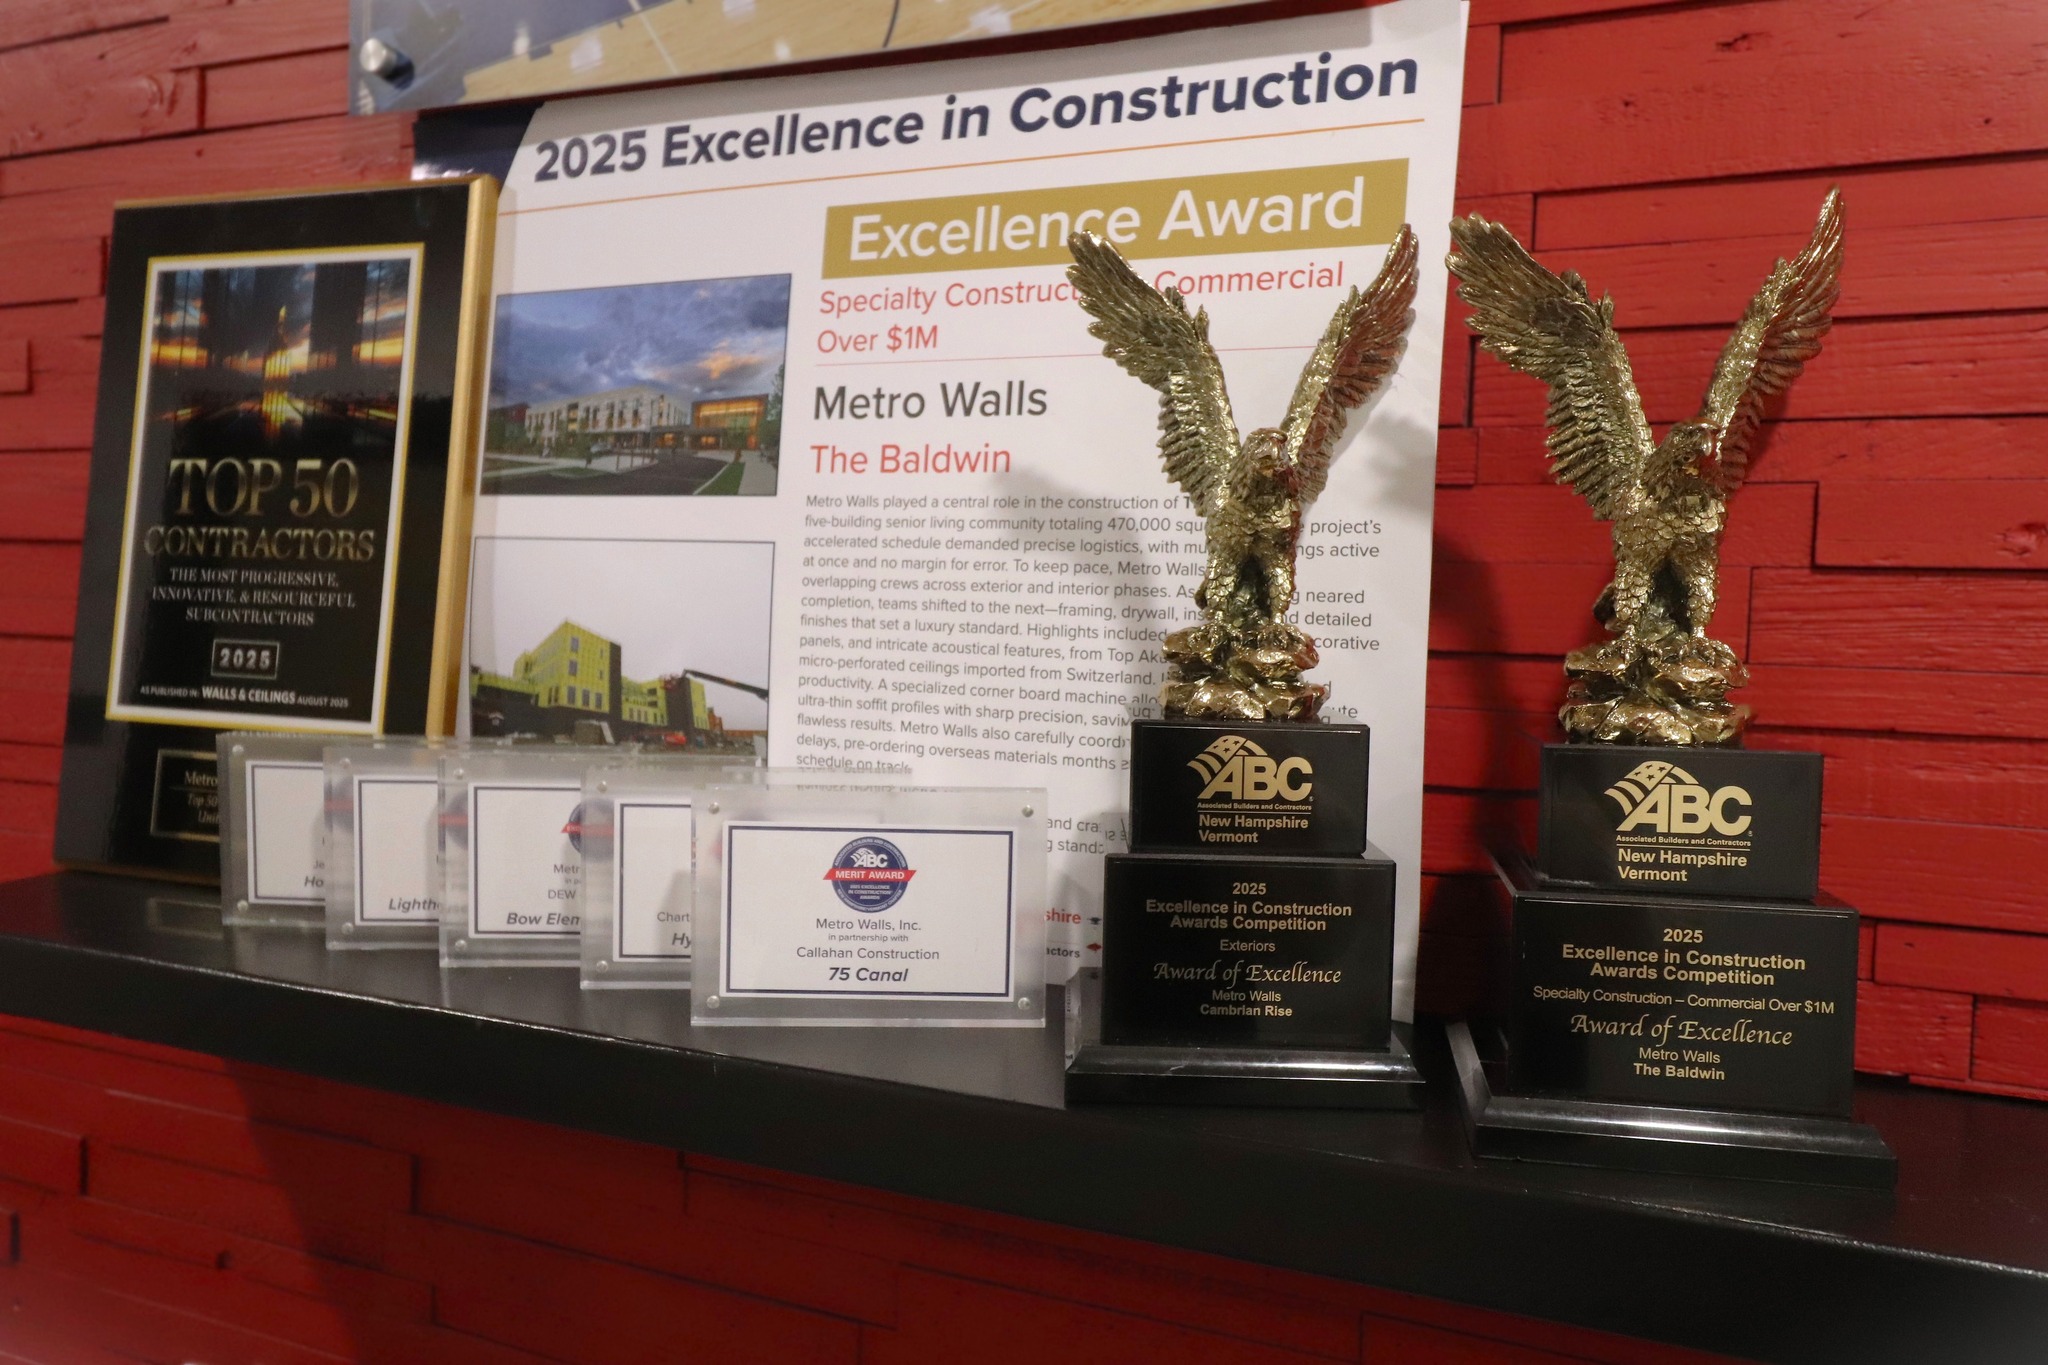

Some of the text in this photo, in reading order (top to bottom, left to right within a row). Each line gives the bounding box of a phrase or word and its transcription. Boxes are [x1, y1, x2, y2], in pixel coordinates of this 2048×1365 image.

[535, 51, 1417, 182] 2025 Excellence in Construction
[849, 177, 1365, 262] Excellence Award
[819, 286, 937, 318] Specialty
[1153, 261, 1344, 295] Commercial
[817, 324, 938, 354] Over $1M
[814, 380, 1048, 420] Metro Walls
[810, 443, 1011, 474] The Baldwin
[167, 457, 359, 517] TOP 50
[806, 495, 1179, 510] Metro Walls played a central role in the construction of
[805, 515, 881, 530] five-building
[886, 517, 926, 528] senior
[931, 517, 965, 531] living
[969, 518, 1044, 533] community
[1050, 518, 1102, 533] totaling
[1108, 518, 1170, 532] 470,000
[145, 527, 375, 562] CONTRACTORS
[803, 557, 1205, 576] at once and no margin for error. To keep pace, Metro Walls
[170, 567, 339, 587] THE MOST PROGRESSIVE,
[153, 586, 356, 608] INNOVATIVE, & RESOURCEFUL
[186, 607, 315, 626] SUBCONTRACTORS
[220, 647, 270, 670] 2025
[799, 655, 1156, 685] micro-perforated ceilings imported from Switzerland.
[140, 686, 149, 694] AS
[150, 687, 188, 697] PUBLISHED
[202, 686, 236, 700] WALLS
[239, 688, 247, 700] &
[249, 688, 295, 704] CEILINGS
[297, 695, 327, 707] AUGUST
[330, 697, 348, 708] 2025
[797, 713, 1074, 747] flawless results. Metro Walls also carefully
[1197, 756, 1313, 801] ABC
[1616, 784, 1752, 836] ABC
[1199, 815, 1308, 830] New Hampshire
[1199, 830, 1258, 843] Vermont
[1616, 834, 1751, 847] Associated Builders and Contractors
[854, 854, 888, 867] ABC
[1618, 849, 1747, 868] New Hampshire
[553, 864, 579, 873] Metr
[1618, 866, 1687, 882] Vermont
[548, 889, 576, 899] DEW
[1233, 883, 1266, 895] 2025
[1146, 899, 1352, 916] Excellence in Construction
[507, 913, 541, 925] Bow
[816, 919, 922, 931] Metro Walls, Inc.
[1170, 915, 1326, 932] Awards Competition
[828, 933, 909, 944] in partnership with
[1663, 928, 1703, 943] 2025
[797, 947, 939, 960] Callahan Construction
[1220, 940, 1276, 952] Exteriors
[1562, 944, 1805, 971] Excellence in Construction
[828, 967, 908, 982] 75 Canal
[1154, 960, 1341, 989] Award of Excellence
[1590, 962, 1774, 986] Awards Competition
[1213, 990, 1281, 1002] Metro Walls
[1533, 986, 1590, 1002] Specialty
[1593, 989, 1672, 1006] Construction
[1688, 994, 1765, 1010] Commercial
[1769, 999, 1802, 1013] Over
[1805, 1000, 1834, 1014] $1M
[1200, 1004, 1292, 1016] Cambrian Rise
[1571, 1014, 1792, 1046] Award of Excellence
[1639, 1048, 1721, 1063] Metro Walls
[1634, 1063, 1725, 1080] The Baldwin
